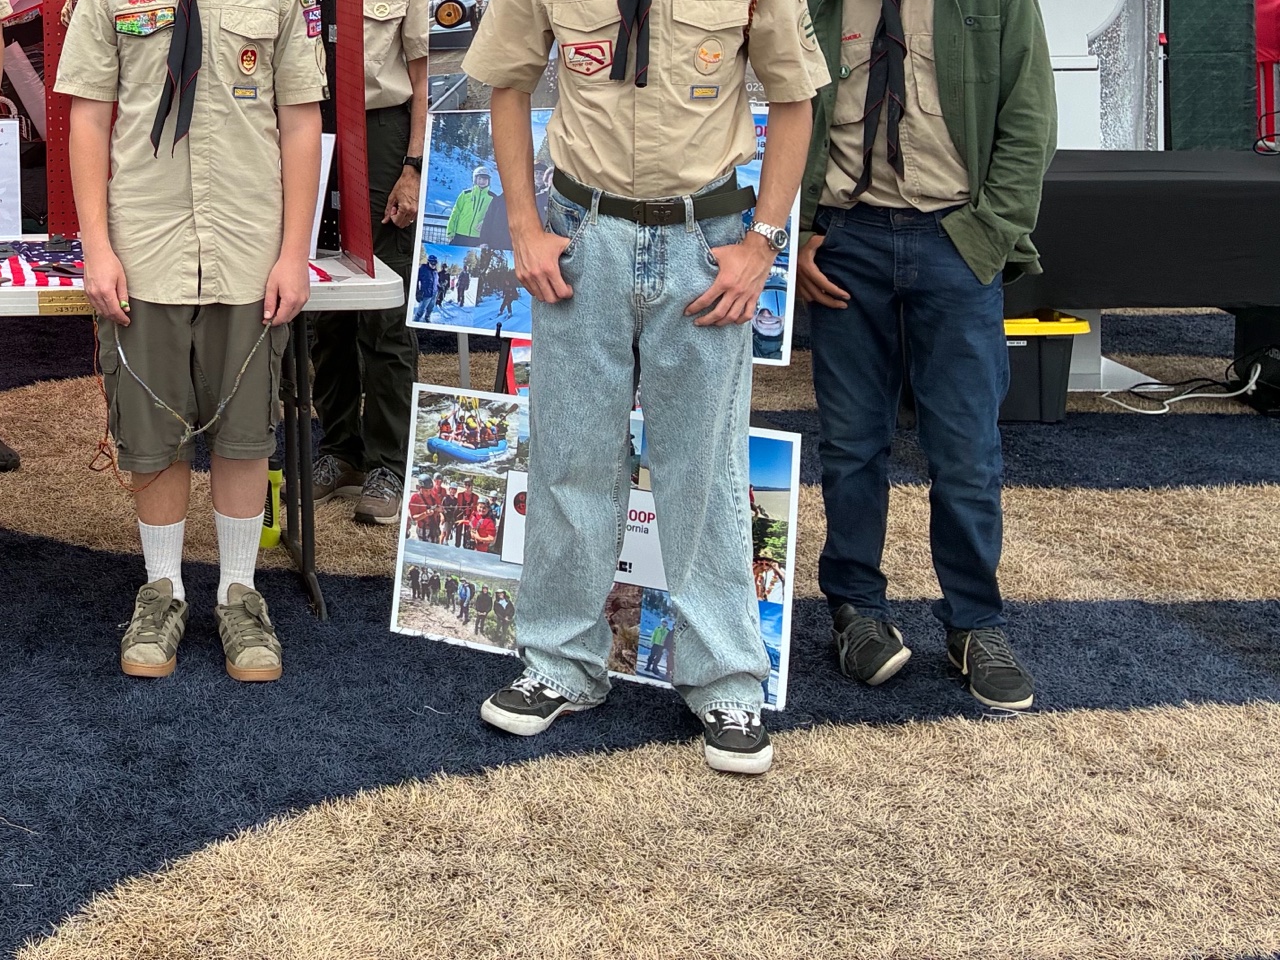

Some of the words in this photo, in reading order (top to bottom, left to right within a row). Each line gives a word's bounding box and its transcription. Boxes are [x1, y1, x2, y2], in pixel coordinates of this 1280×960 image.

[745, 82, 765, 92] 023
[628, 508, 657, 525] OOP
[625, 523, 650, 535] ornia
